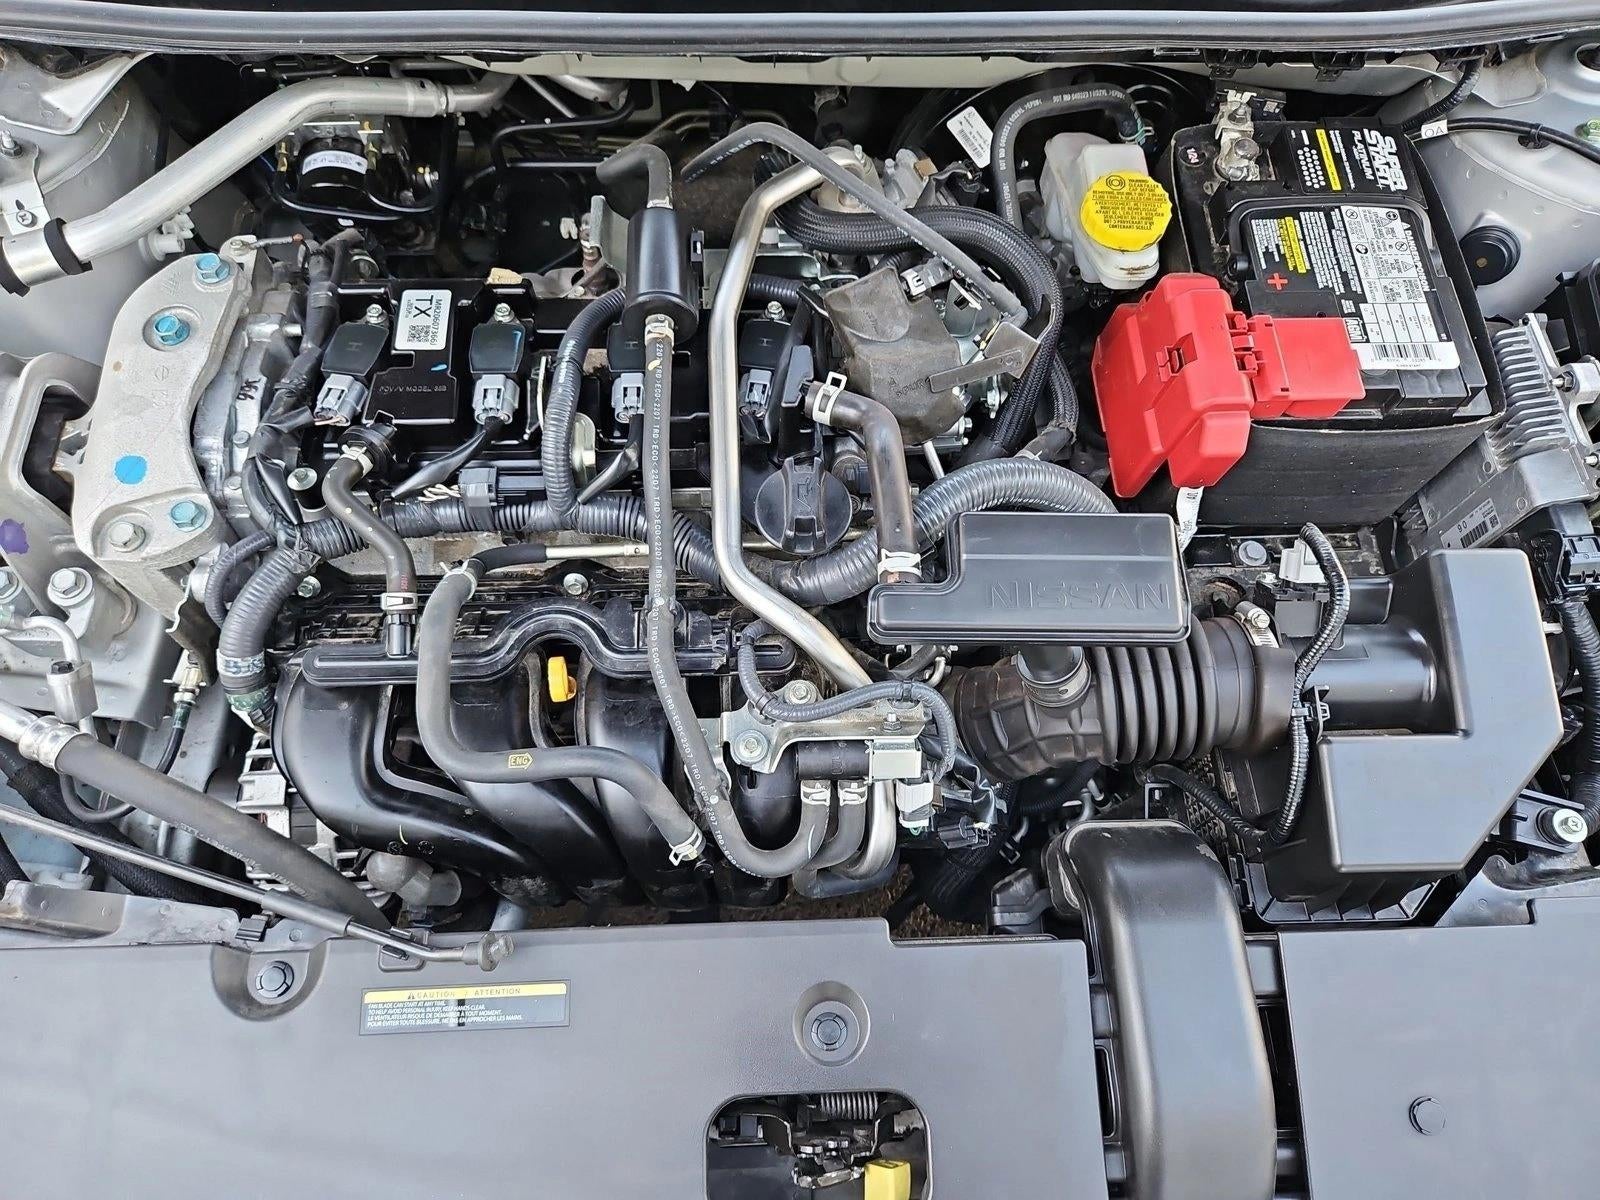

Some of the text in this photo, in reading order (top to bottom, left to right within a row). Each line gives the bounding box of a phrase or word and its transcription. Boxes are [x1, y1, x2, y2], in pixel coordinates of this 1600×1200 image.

[1352, 130, 1374, 180] PLATINUM
[1363, 128, 1396, 192] START
[1384, 136, 1408, 190] SUPER
[1403, 229, 1430, 291] DANGER/POISON
[413, 294, 434, 318] TX
[1345, 319, 1362, 339] AGM
[986, 580, 1171, 610] NISSAN
[511, 756, 529, 766] ENG
[416, 990, 456, 1000] CAUTION
[474, 988, 520, 996] ATTENTION
